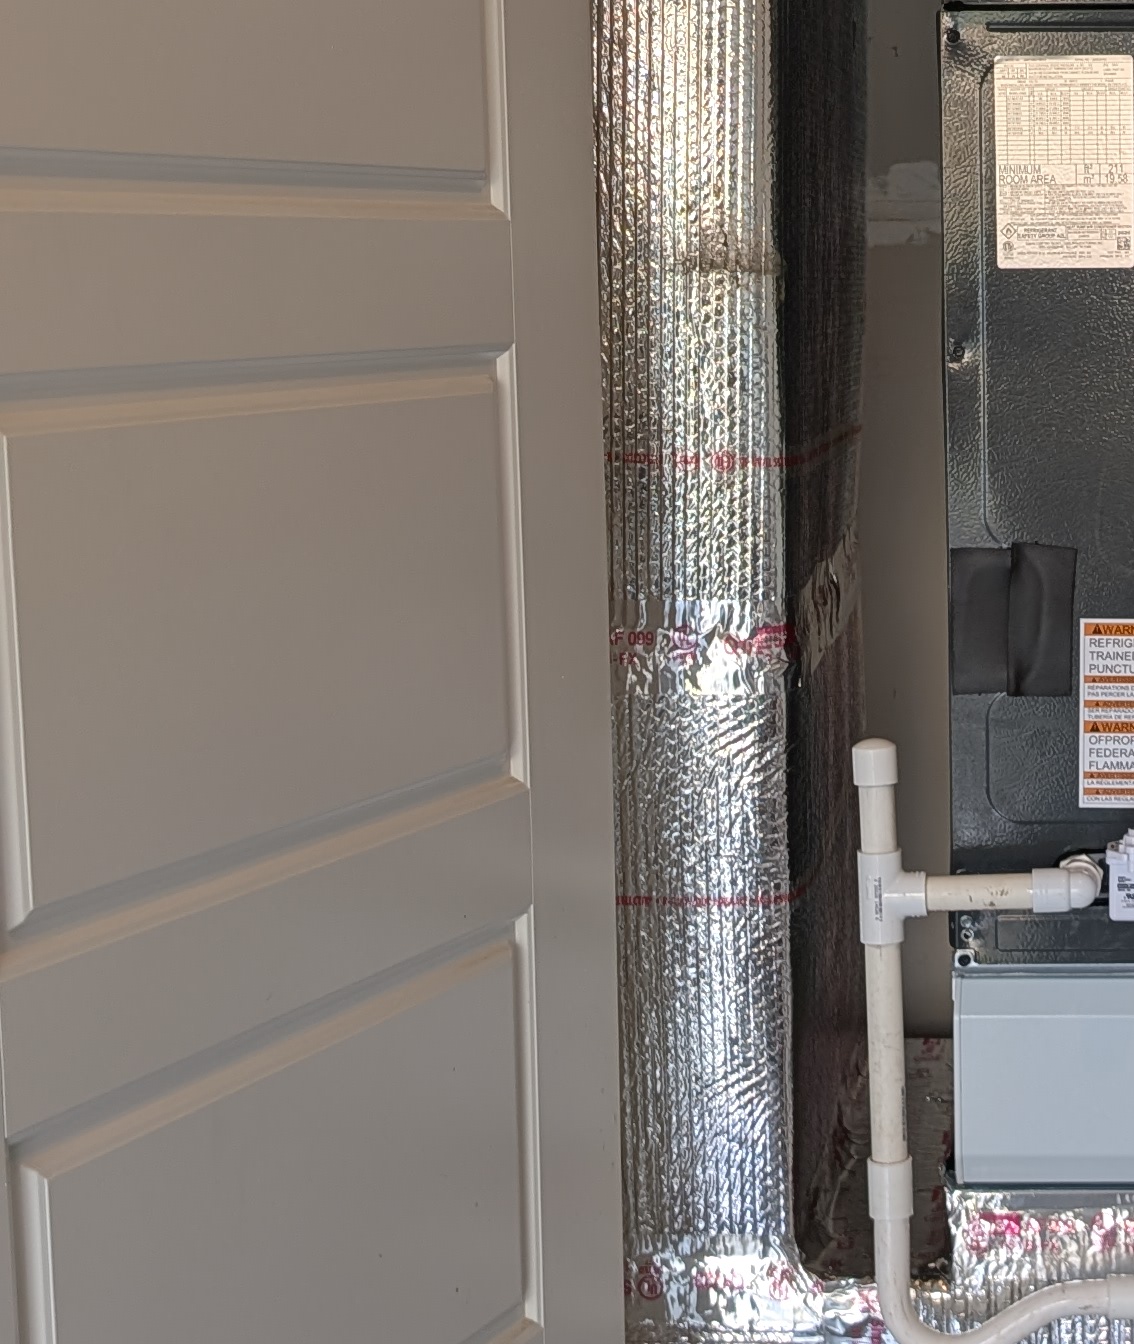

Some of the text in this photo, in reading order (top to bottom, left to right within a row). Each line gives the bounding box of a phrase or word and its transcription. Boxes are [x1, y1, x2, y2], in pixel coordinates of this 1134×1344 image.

[999, 165, 1041, 174] MINIMUM
[999, 175, 1056, 184] ROOM AREA
